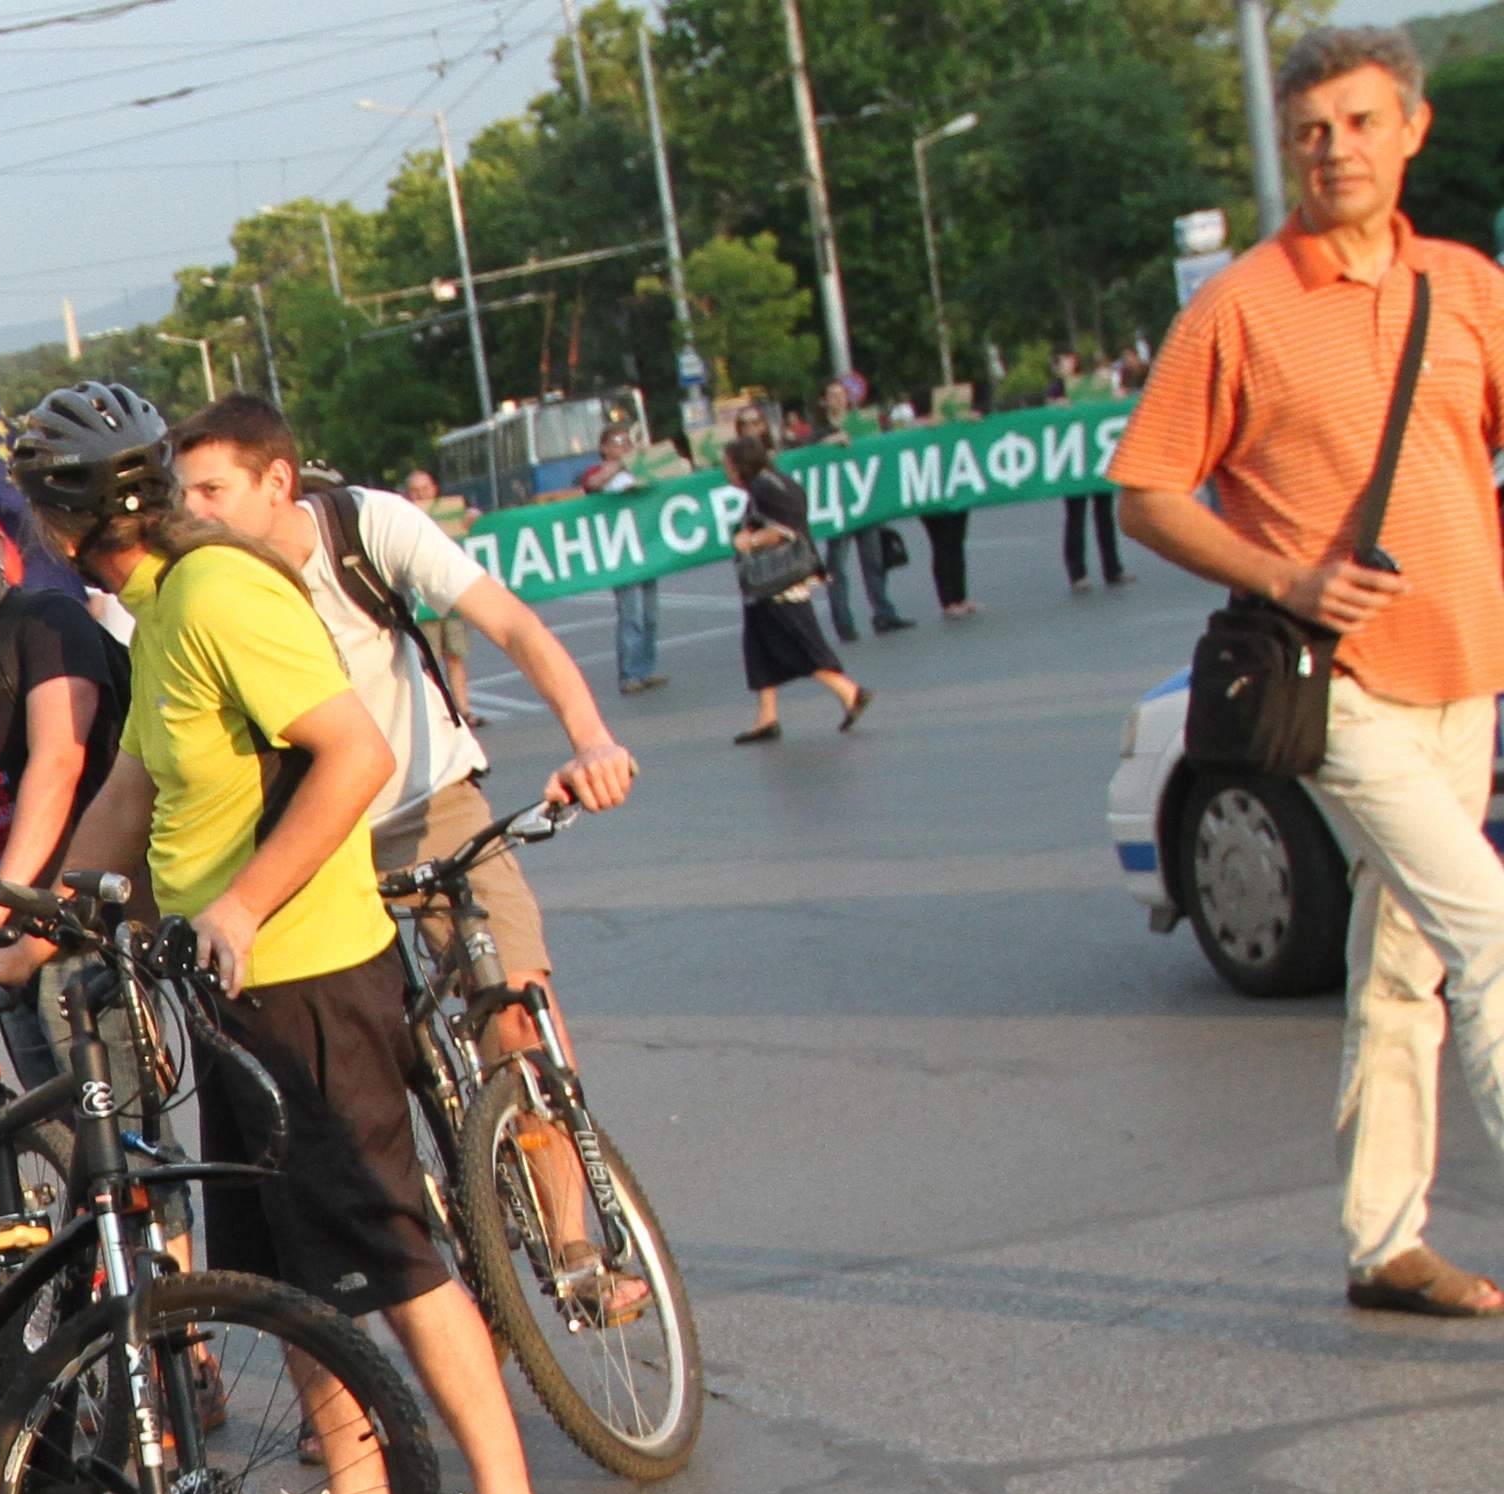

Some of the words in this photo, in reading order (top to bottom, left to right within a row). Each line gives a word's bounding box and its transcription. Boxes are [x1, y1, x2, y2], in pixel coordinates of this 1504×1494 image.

[464, 508, 645, 590] ДАНИ
[659, 455, 880, 554] СРЩУ
[898, 416, 1130, 507] МАФИЯ
